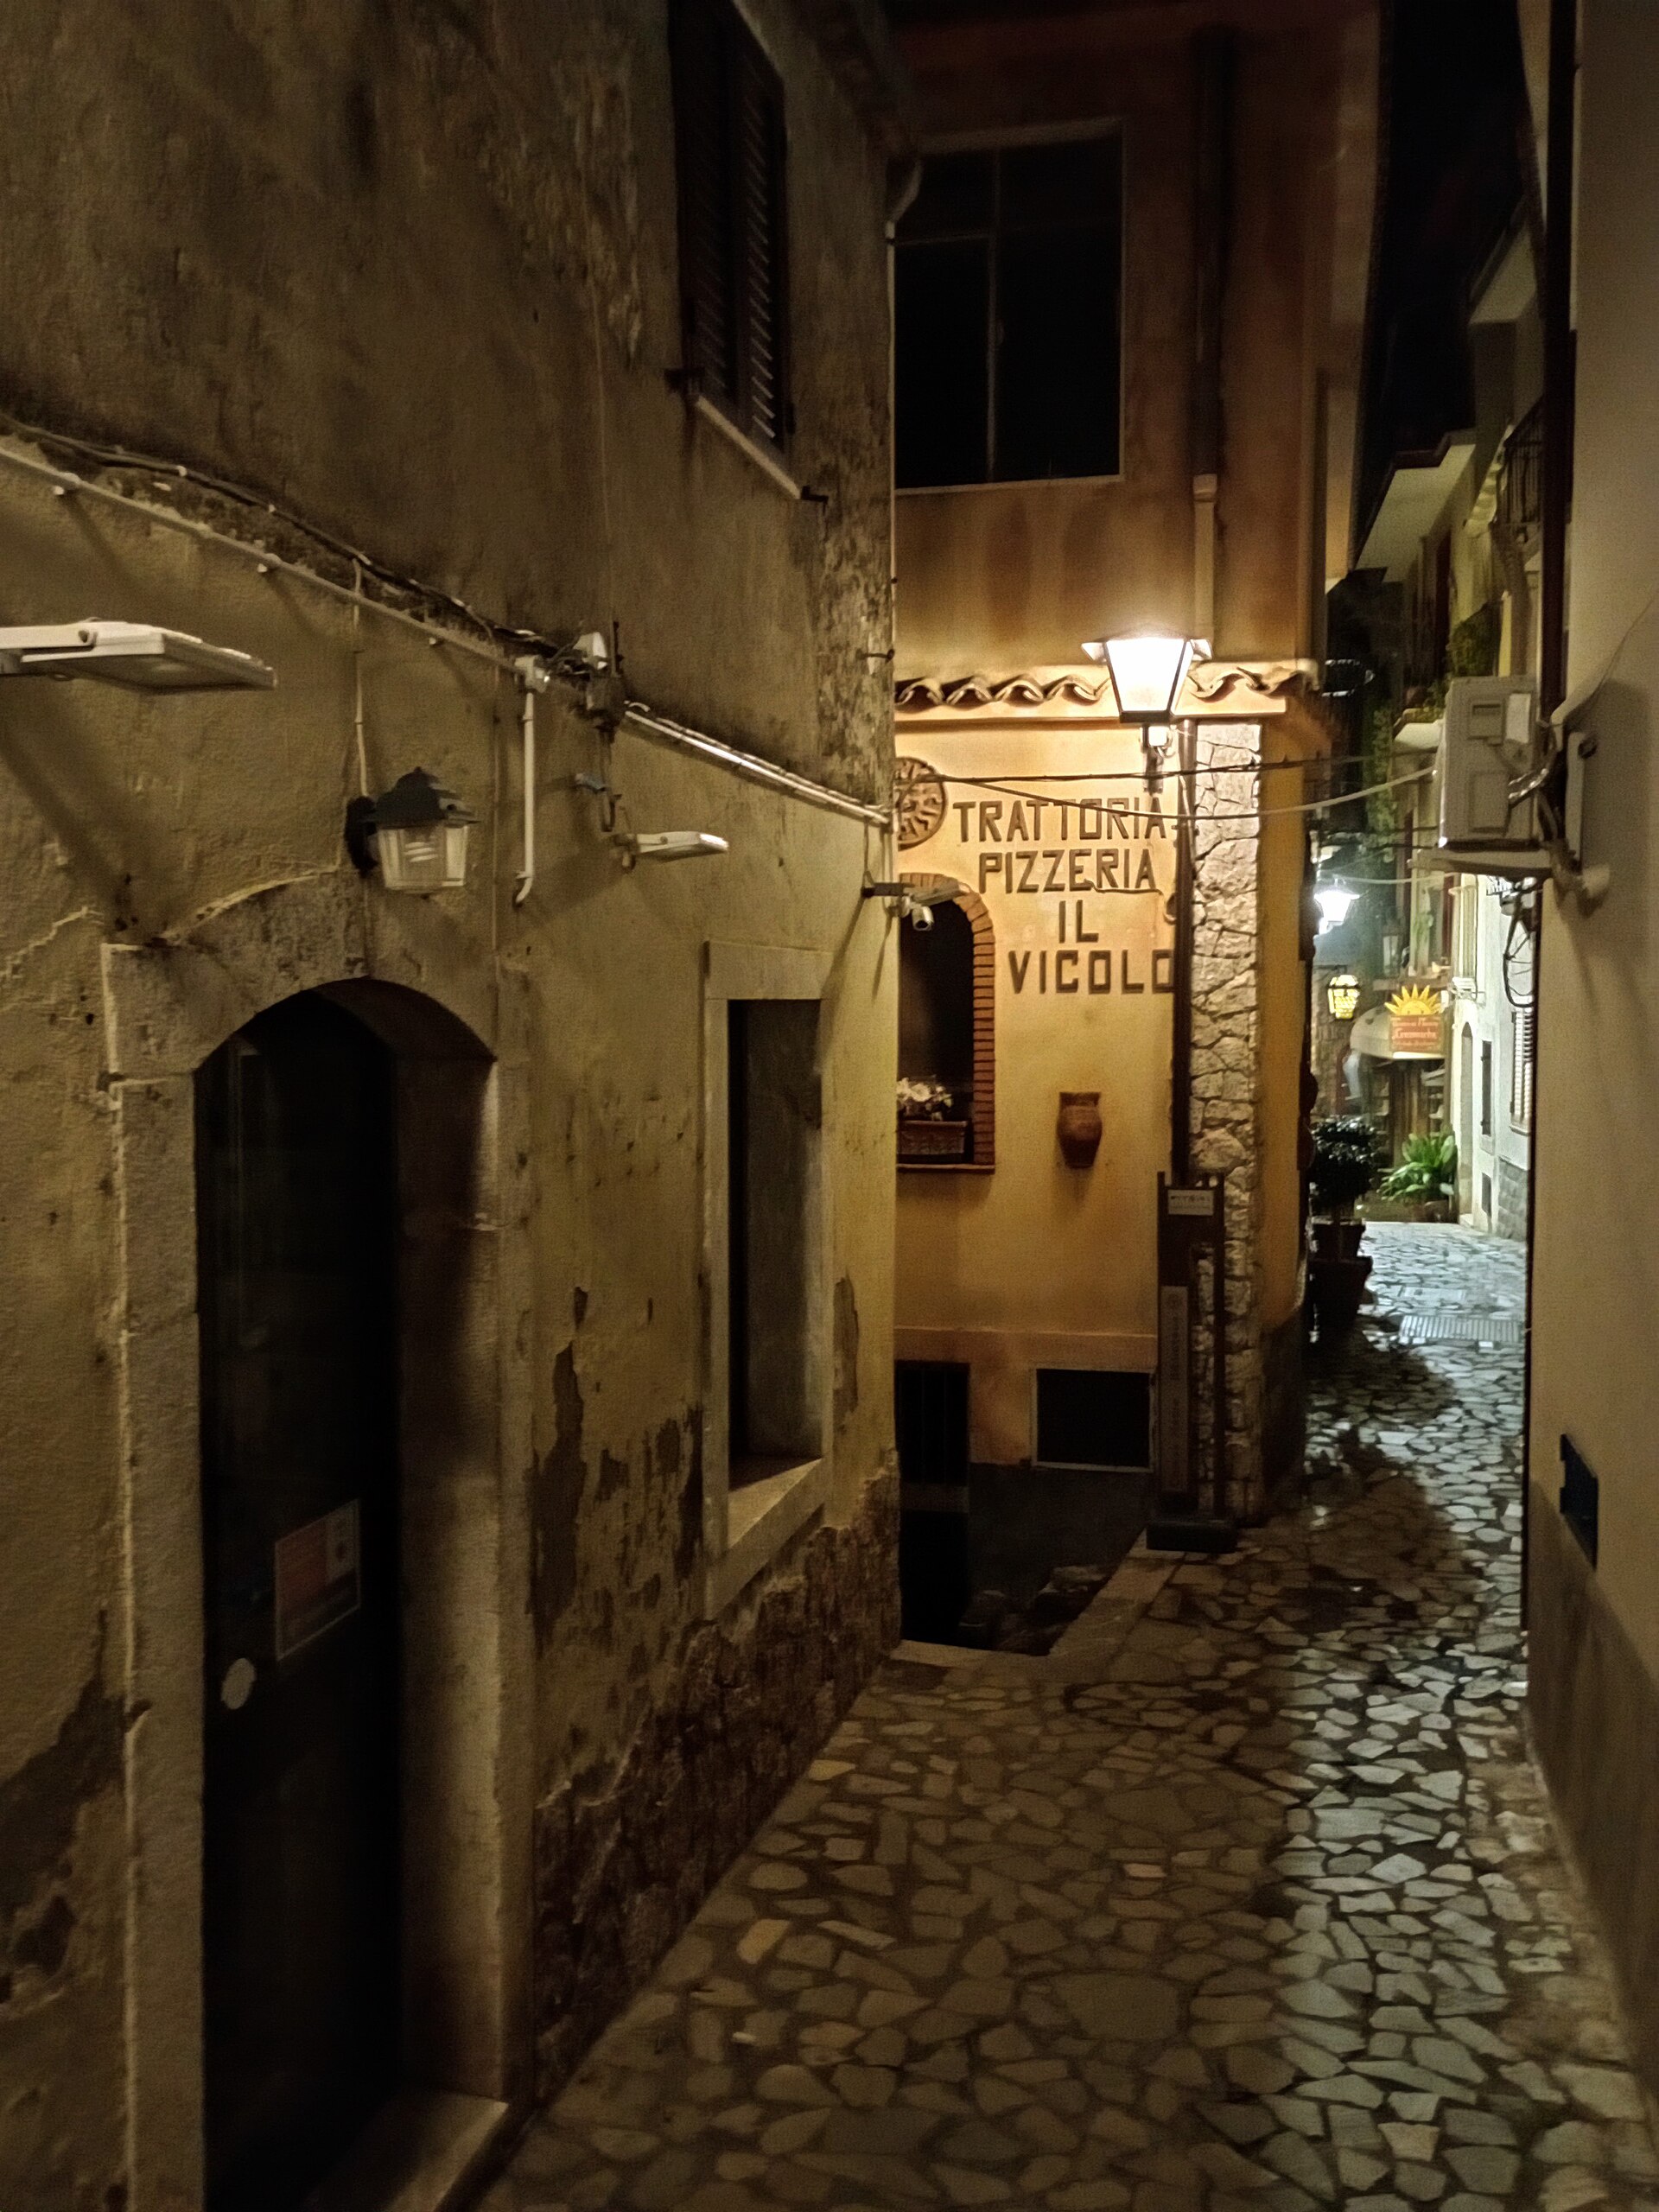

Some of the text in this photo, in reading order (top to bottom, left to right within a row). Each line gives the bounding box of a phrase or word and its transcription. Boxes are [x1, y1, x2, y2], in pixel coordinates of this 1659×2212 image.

[952, 797, 1166, 842] TRATTORIA
[979, 849, 1156, 894] PIZZERIA
[1058, 899, 1099, 944] IL
[1007, 949, 1174, 995] VICOLO
